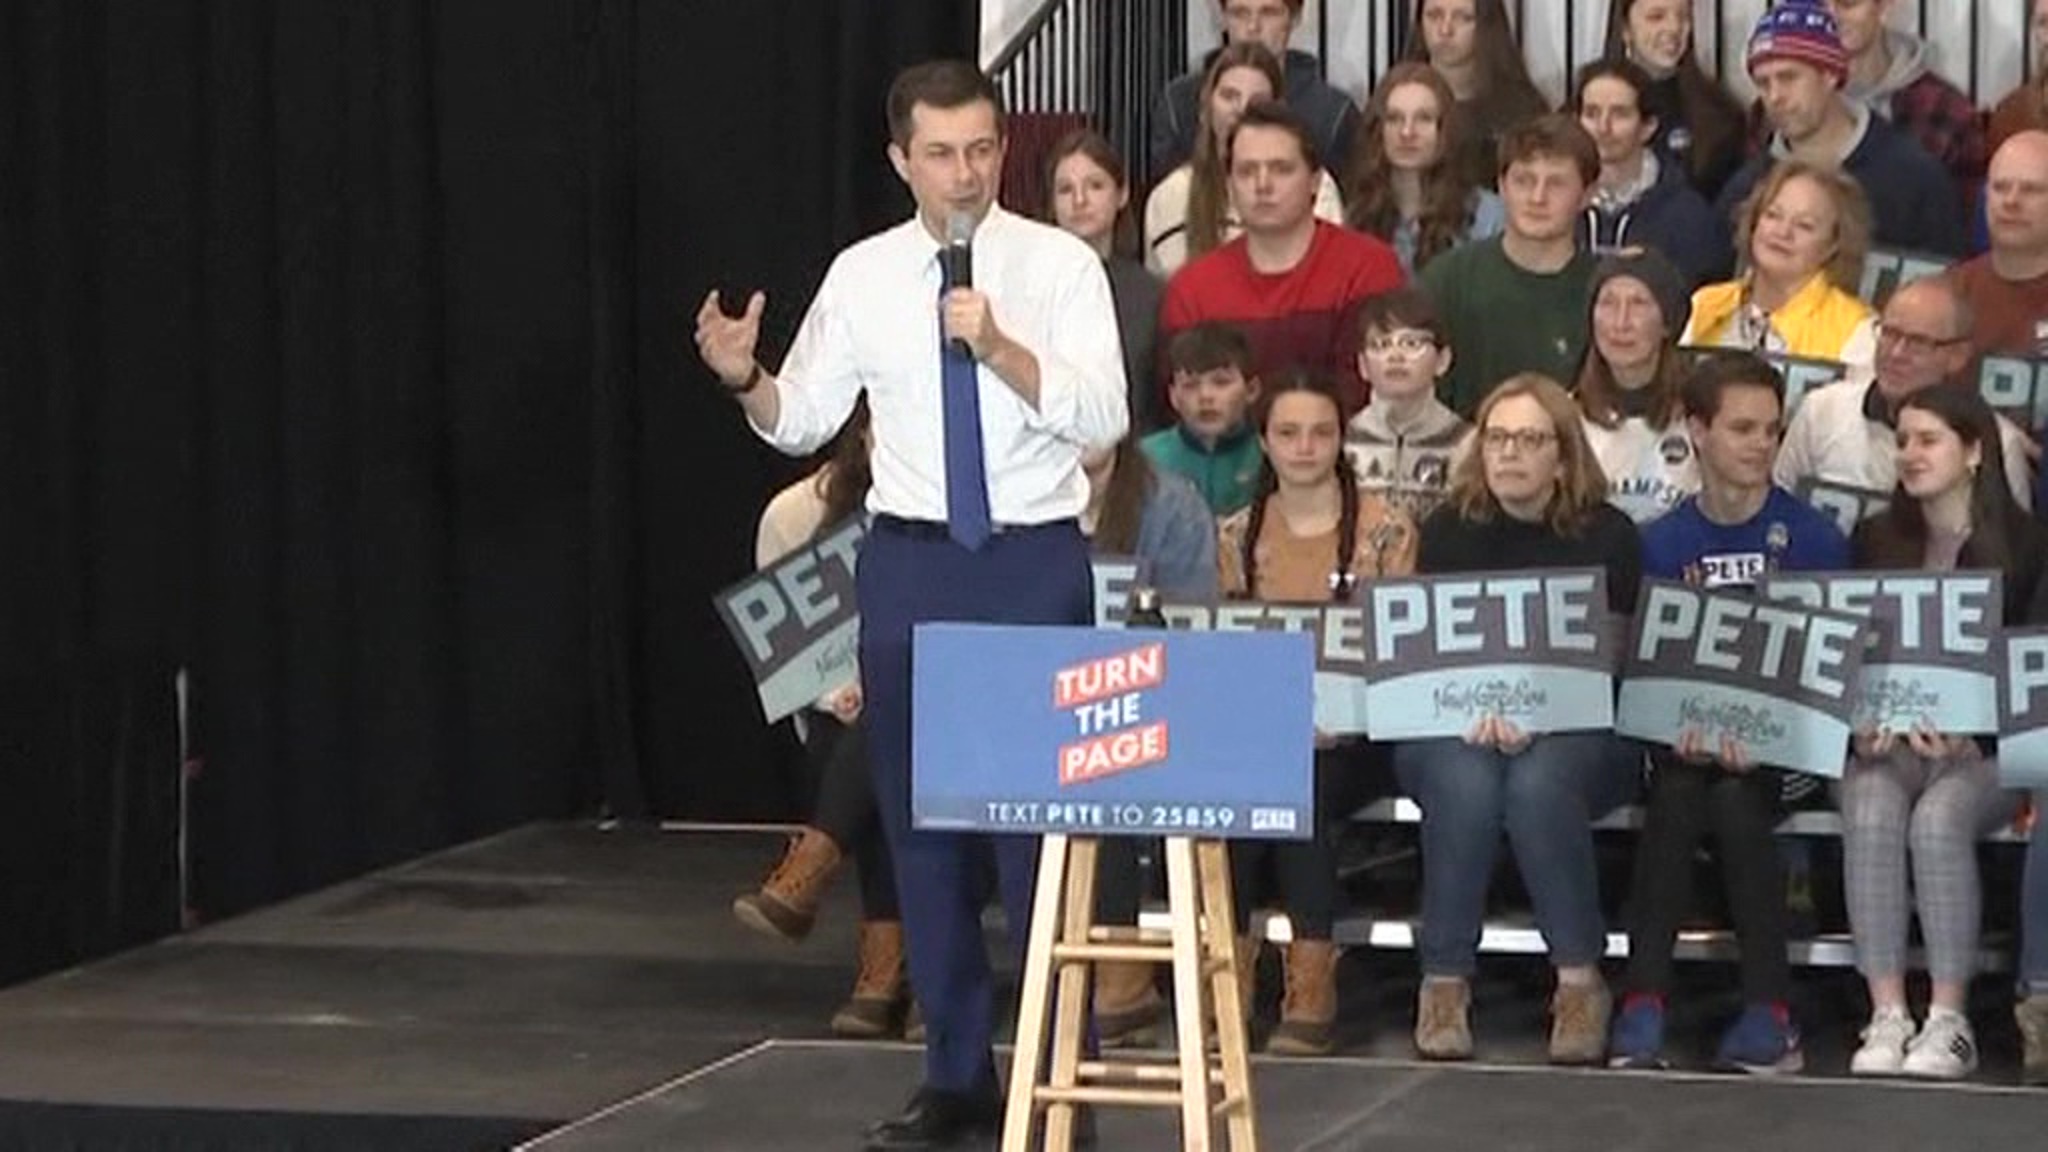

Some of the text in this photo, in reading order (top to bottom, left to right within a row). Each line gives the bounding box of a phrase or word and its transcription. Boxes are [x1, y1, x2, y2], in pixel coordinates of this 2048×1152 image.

[727, 522, 865, 662] PET
[1373, 574, 1598, 661] PETE
[1637, 585, 1859, 698] PETE
[1056, 643, 1163, 701] TURN
[1074, 692, 1141, 735] THE
[1065, 725, 1160, 780] PAGE
[987, 802, 1234, 828] TEXT PETE TO 25859
